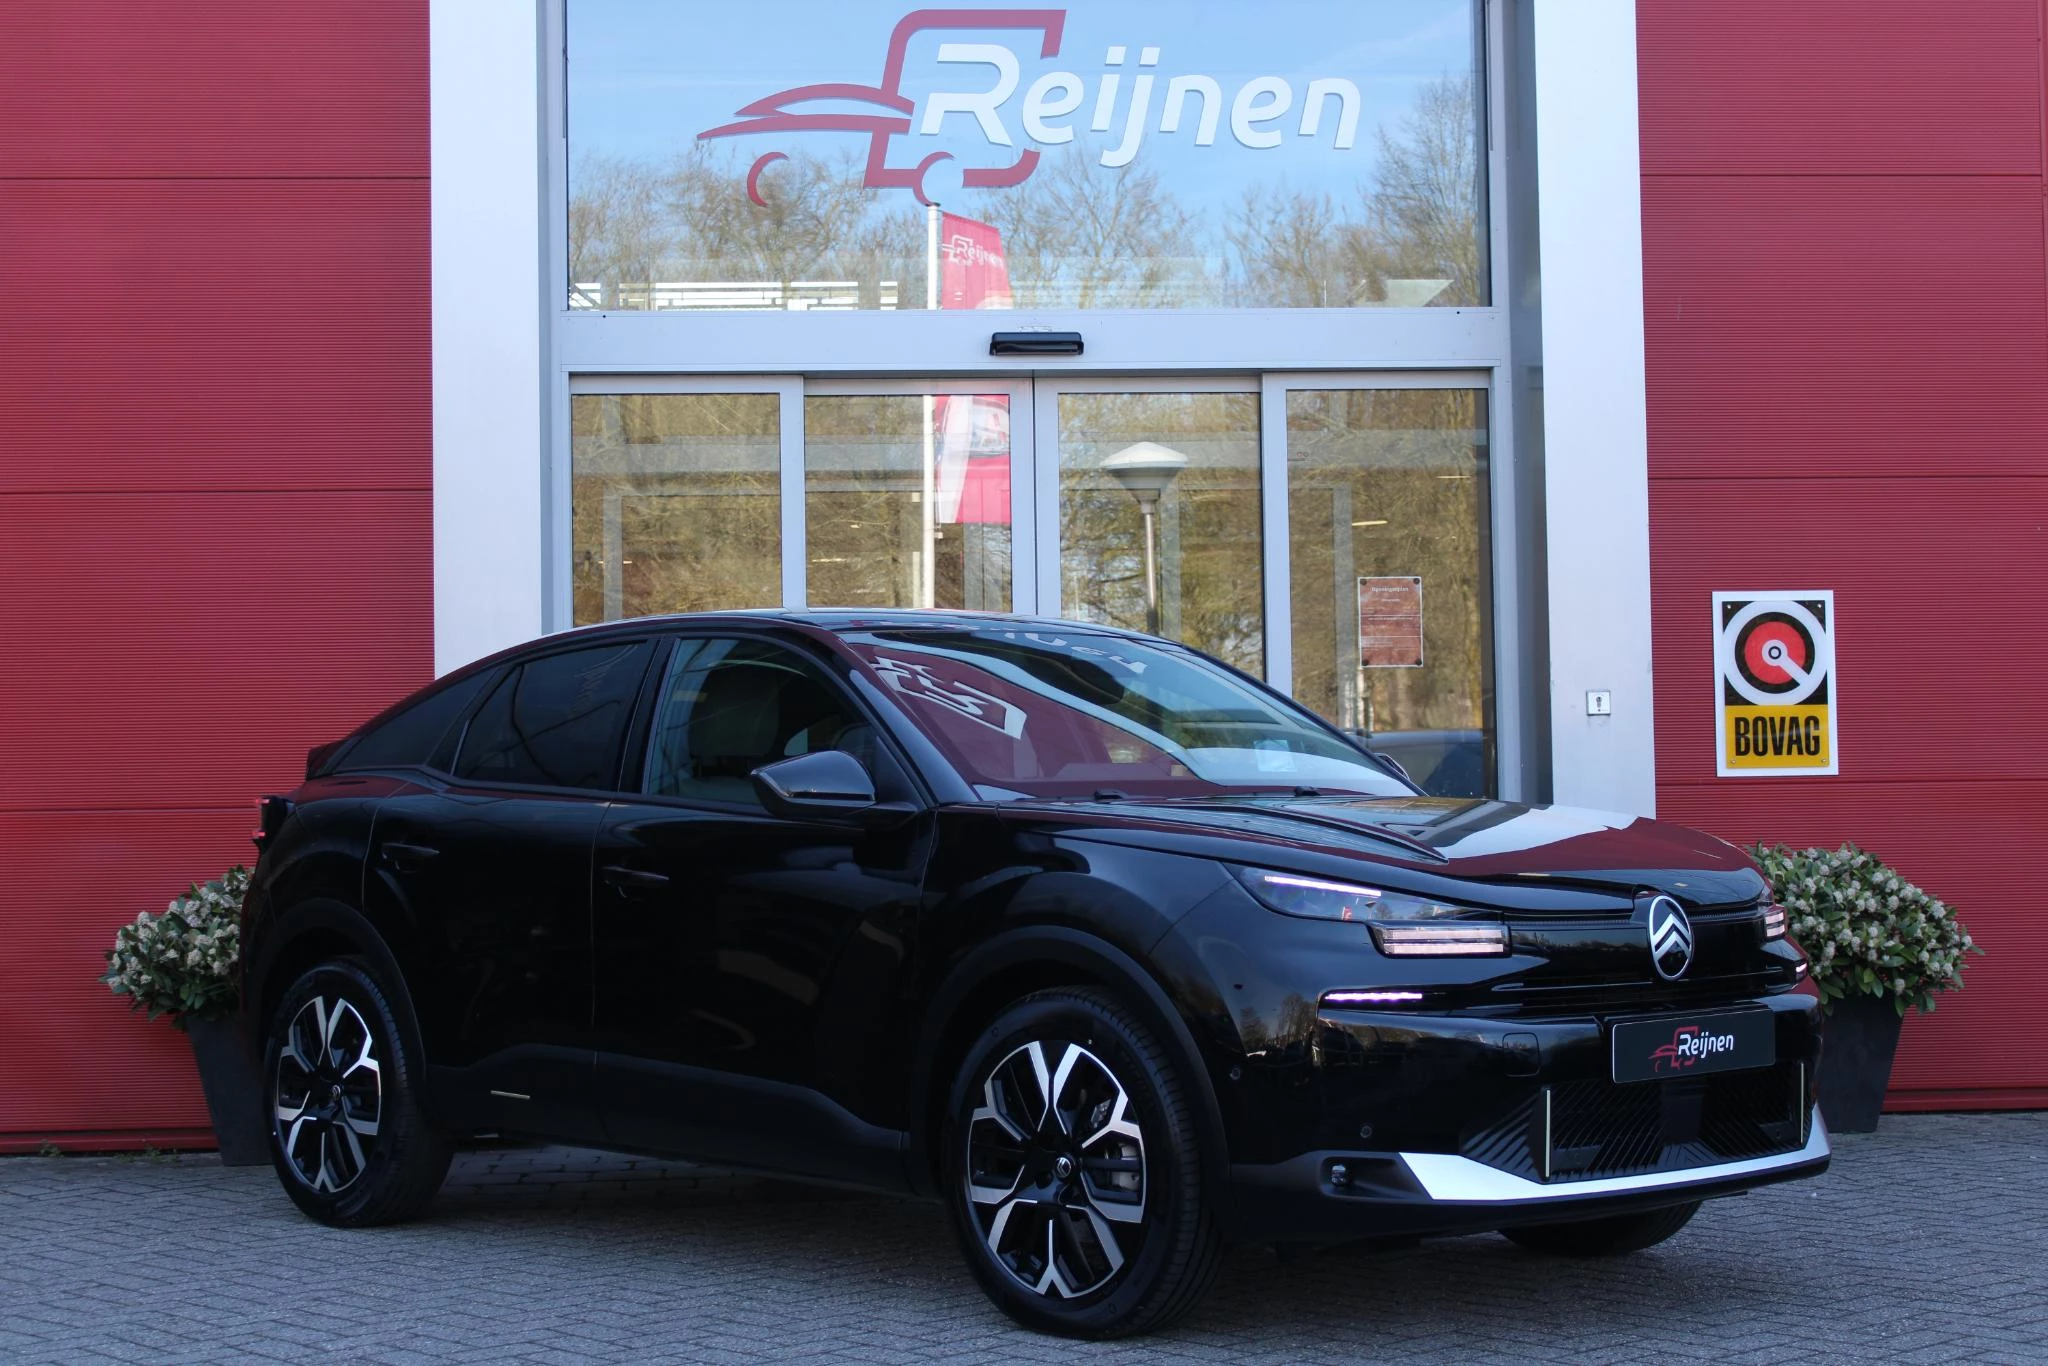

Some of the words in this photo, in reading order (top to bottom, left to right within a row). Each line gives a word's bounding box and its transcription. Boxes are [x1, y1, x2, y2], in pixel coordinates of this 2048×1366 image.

[919, 43, 1361, 168] Reijnen
[1734, 716, 1820, 757] BOVAG
[1678, 1031, 1734, 1058] Reijnen
